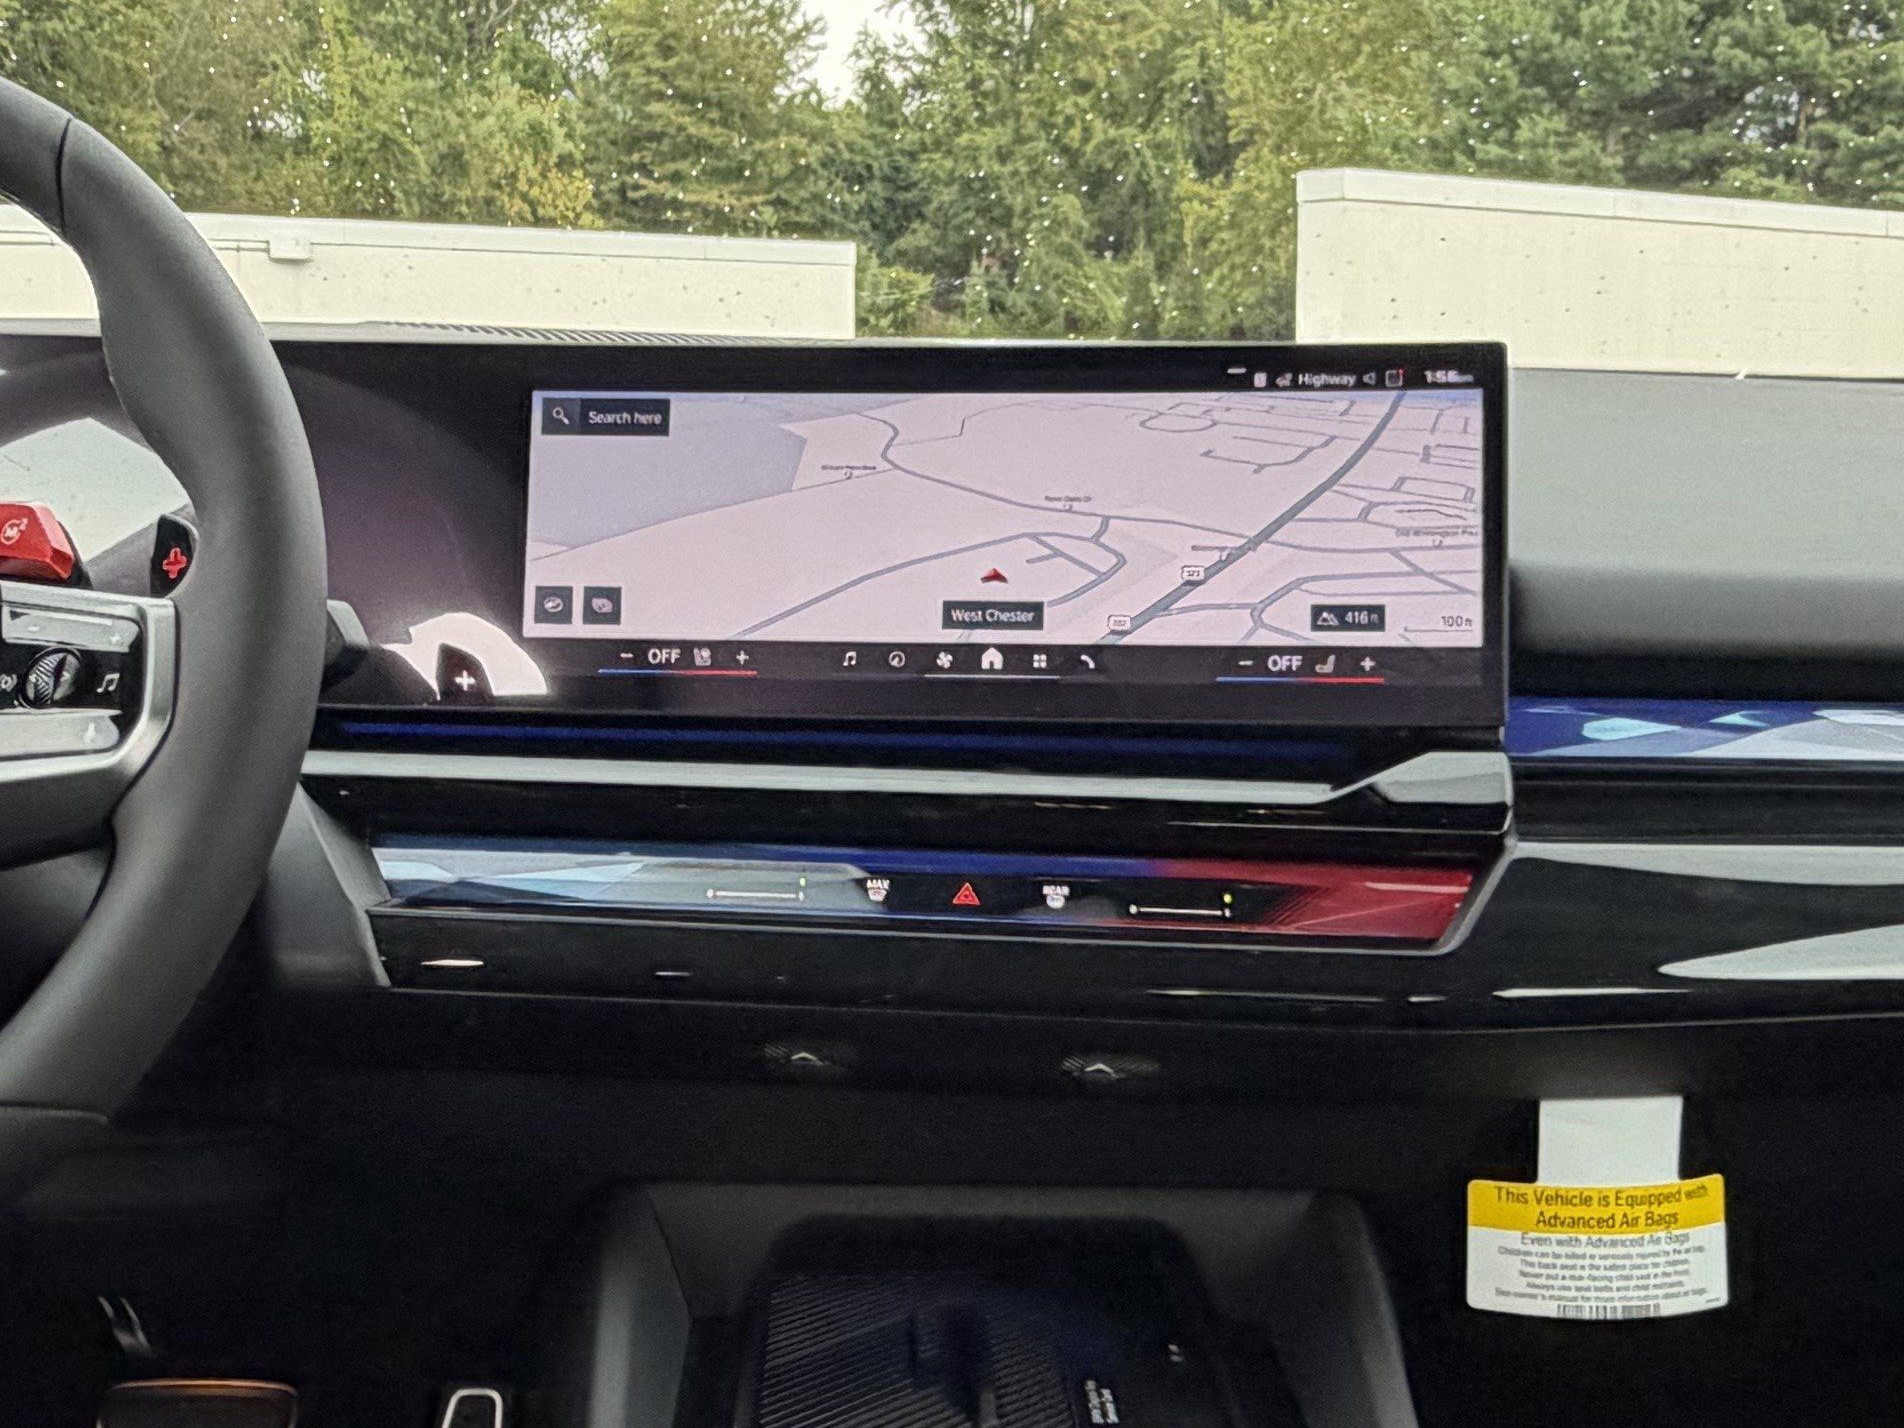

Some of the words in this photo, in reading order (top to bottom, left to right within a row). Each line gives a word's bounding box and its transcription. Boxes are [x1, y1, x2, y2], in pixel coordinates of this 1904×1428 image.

[1298, 373, 1357, 387] Highway
[587, 409, 631, 426] Search
[633, 409, 662, 425] here
[951, 607, 982, 623] West
[985, 607, 1035, 623] Chester
[1344, 611, 1369, 625] 416
[1441, 615, 1464, 627] 100
[648, 649, 681, 665] OFF
[1267, 655, 1302, 671] OFF
[1495, 1186, 1530, 1204] This
[1533, 1188, 1593, 1207] Vehicle
[1597, 1192, 1611, 1208] is
[1614, 1187, 1682, 1209] Equipped
[1535, 1210, 1616, 1229] Advanced
[1619, 1212, 1641, 1229] Air
[1643, 1210, 1679, 1229] Bags
[1520, 1232, 1553, 1246] Even
[1554, 1234, 1582, 1247] with
[1585, 1234, 1645, 1248] Advanced
